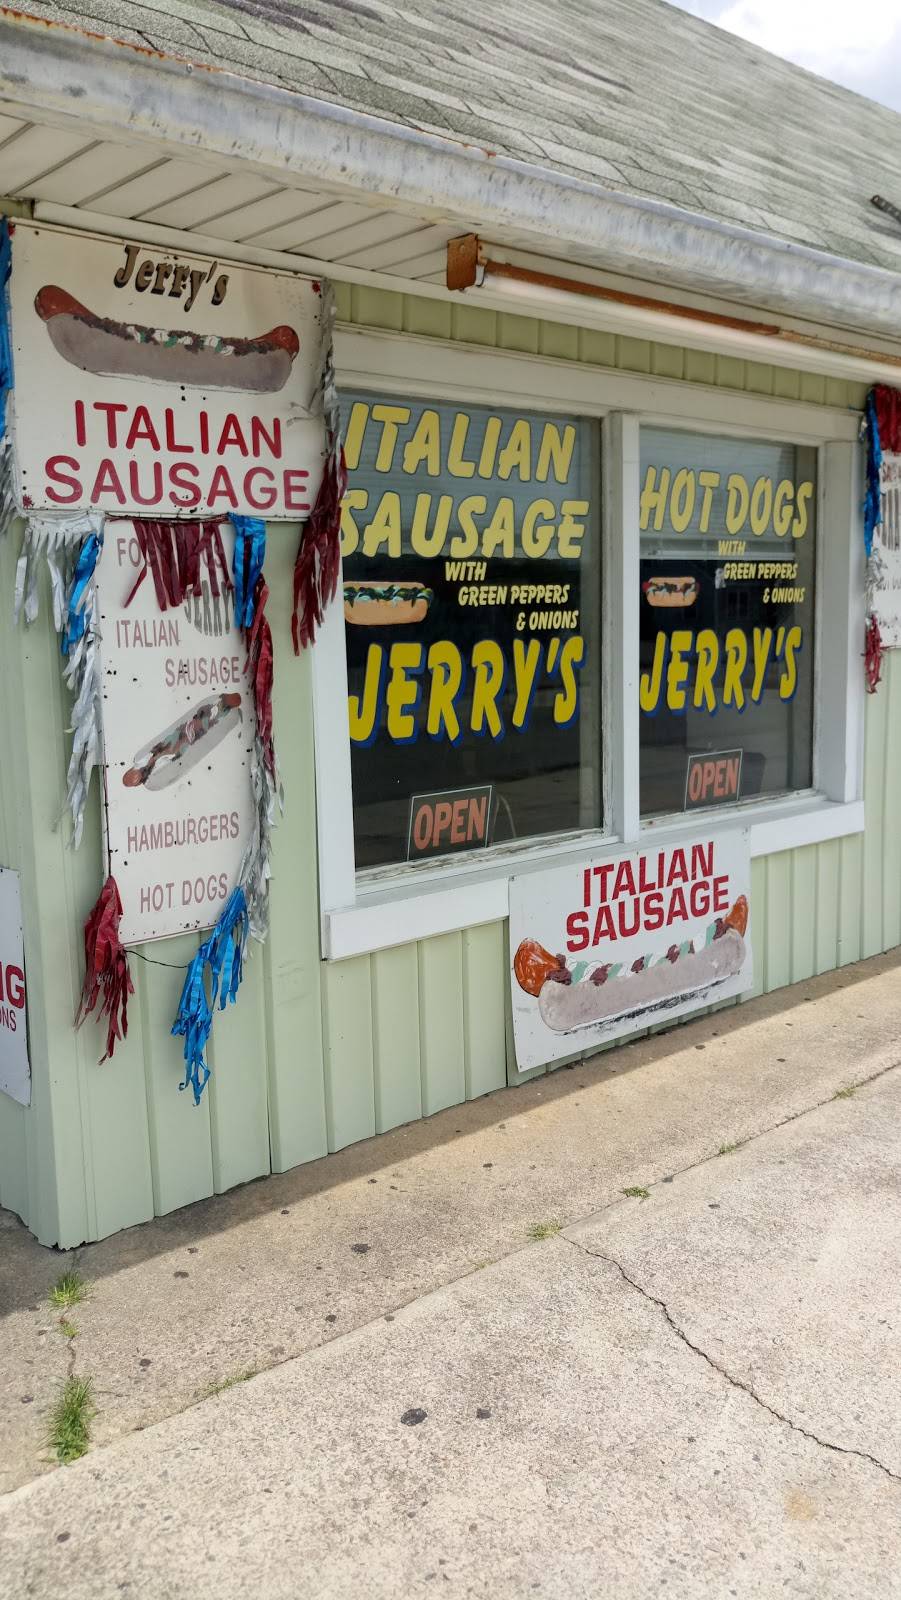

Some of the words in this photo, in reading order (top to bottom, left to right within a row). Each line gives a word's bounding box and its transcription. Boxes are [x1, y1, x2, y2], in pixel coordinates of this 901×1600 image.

[113, 244, 229, 312] Jerry's
[74, 400, 282, 459] ITALIAN
[344, 402, 577, 484] ITALIAN
[44, 455, 311, 511] SAUSAGE
[639, 465, 721, 533] HOT
[726, 474, 813, 538] DOGS
[340, 489, 590, 559] SAUSAGE
[718, 540, 746, 556] WITH
[445, 561, 487, 581] WITH
[723, 563, 756, 580] GREEN
[758, 562, 798, 580] PEPPERS
[763, 588, 770, 603] &
[771, 587, 805, 603] ONIONS
[458, 586, 508, 607] GREEN
[510, 584, 570, 606] PEPPERS
[116, 620, 180, 648] ITALIAN
[516, 611, 526, 631] &
[529, 610, 579, 630] ONIONS
[165, 656, 241, 687] SAUSAGE
[348, 636, 587, 746] JERRY'S
[640, 626, 803, 717] JERRY'S
[688, 758, 740, 801] OPEN
[127, 812, 240, 853] HAMBURGERS
[413, 796, 487, 850] OPEN
[140, 883, 175, 913] HOT
[182, 873, 228, 906] DOGS
[583, 841, 714, 907] ITALIAN
[566, 875, 729, 953] SAUSAGE
